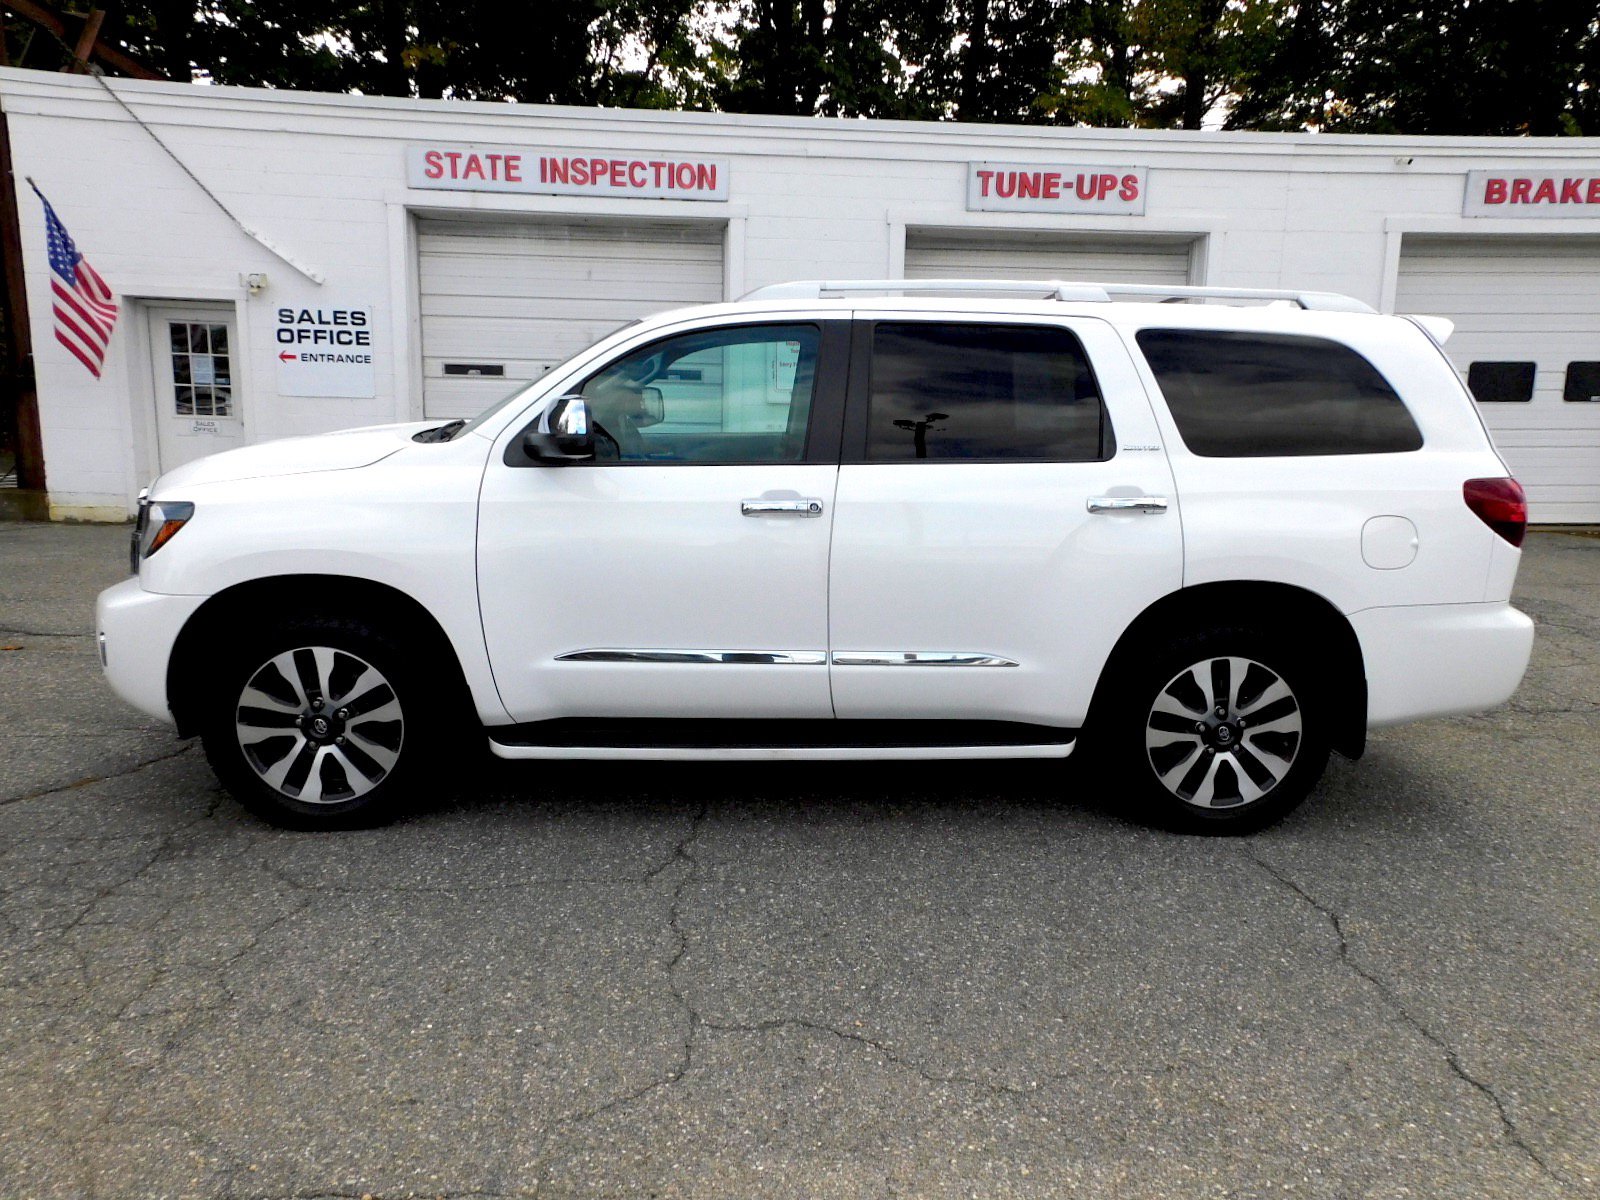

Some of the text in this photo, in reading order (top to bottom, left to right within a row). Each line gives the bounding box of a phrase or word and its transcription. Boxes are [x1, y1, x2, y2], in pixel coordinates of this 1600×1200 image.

[424, 150, 717, 190] STATE INSPECTION
[976, 170, 1139, 201] TUNE-UPS
[1484, 178, 1600, 204] BRAKE
[278, 308, 367, 326] SALES
[277, 328, 370, 346] OFFICE
[300, 353, 372, 364] ENTRANCE
